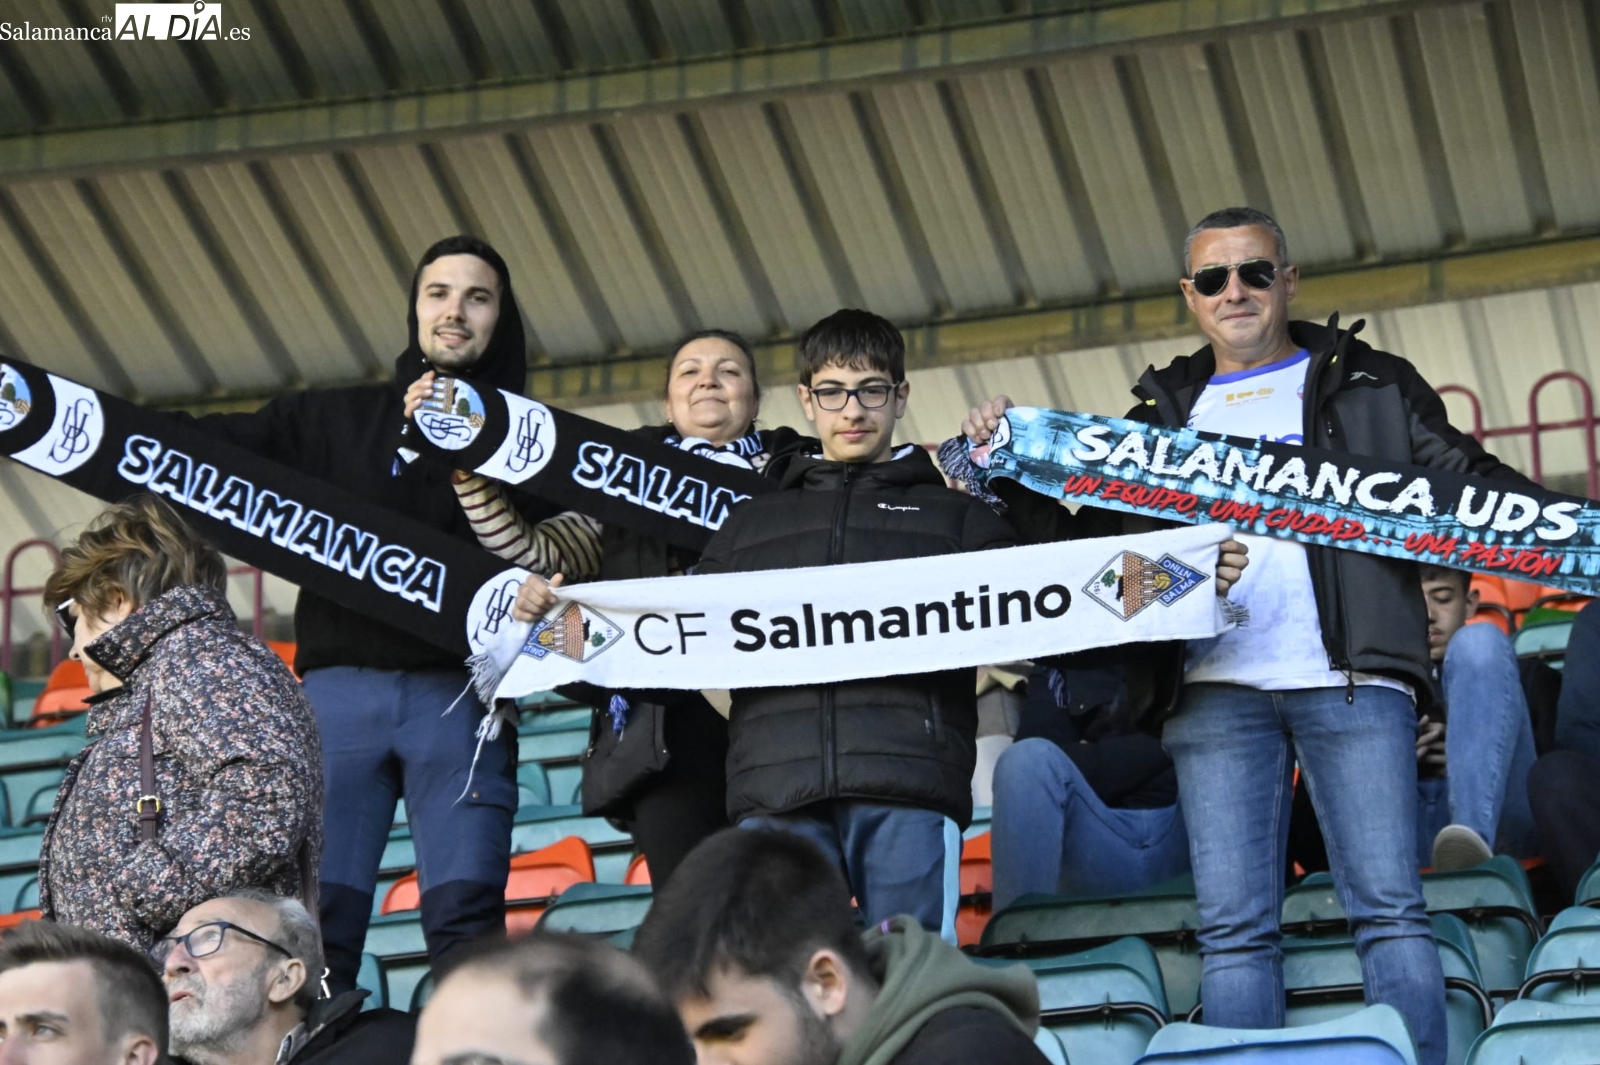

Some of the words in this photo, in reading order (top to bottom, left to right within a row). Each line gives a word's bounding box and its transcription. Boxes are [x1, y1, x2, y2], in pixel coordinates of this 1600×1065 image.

[117, 434, 446, 613] SALAMANCA
[1063, 474, 1102, 496] UN
[1100, 479, 1198, 519] EQUIPO,
[1209, 499, 1264, 527] UNA
[1404, 532, 1461, 560] UNA
[1460, 541, 1564, 578] PASIÓN
[1072, 424, 1437, 518] SALAMANCA
[1455, 485, 1582, 541] UDS
[634, 612, 708, 656] CF
[729, 583, 1073, 653] Salmantino
